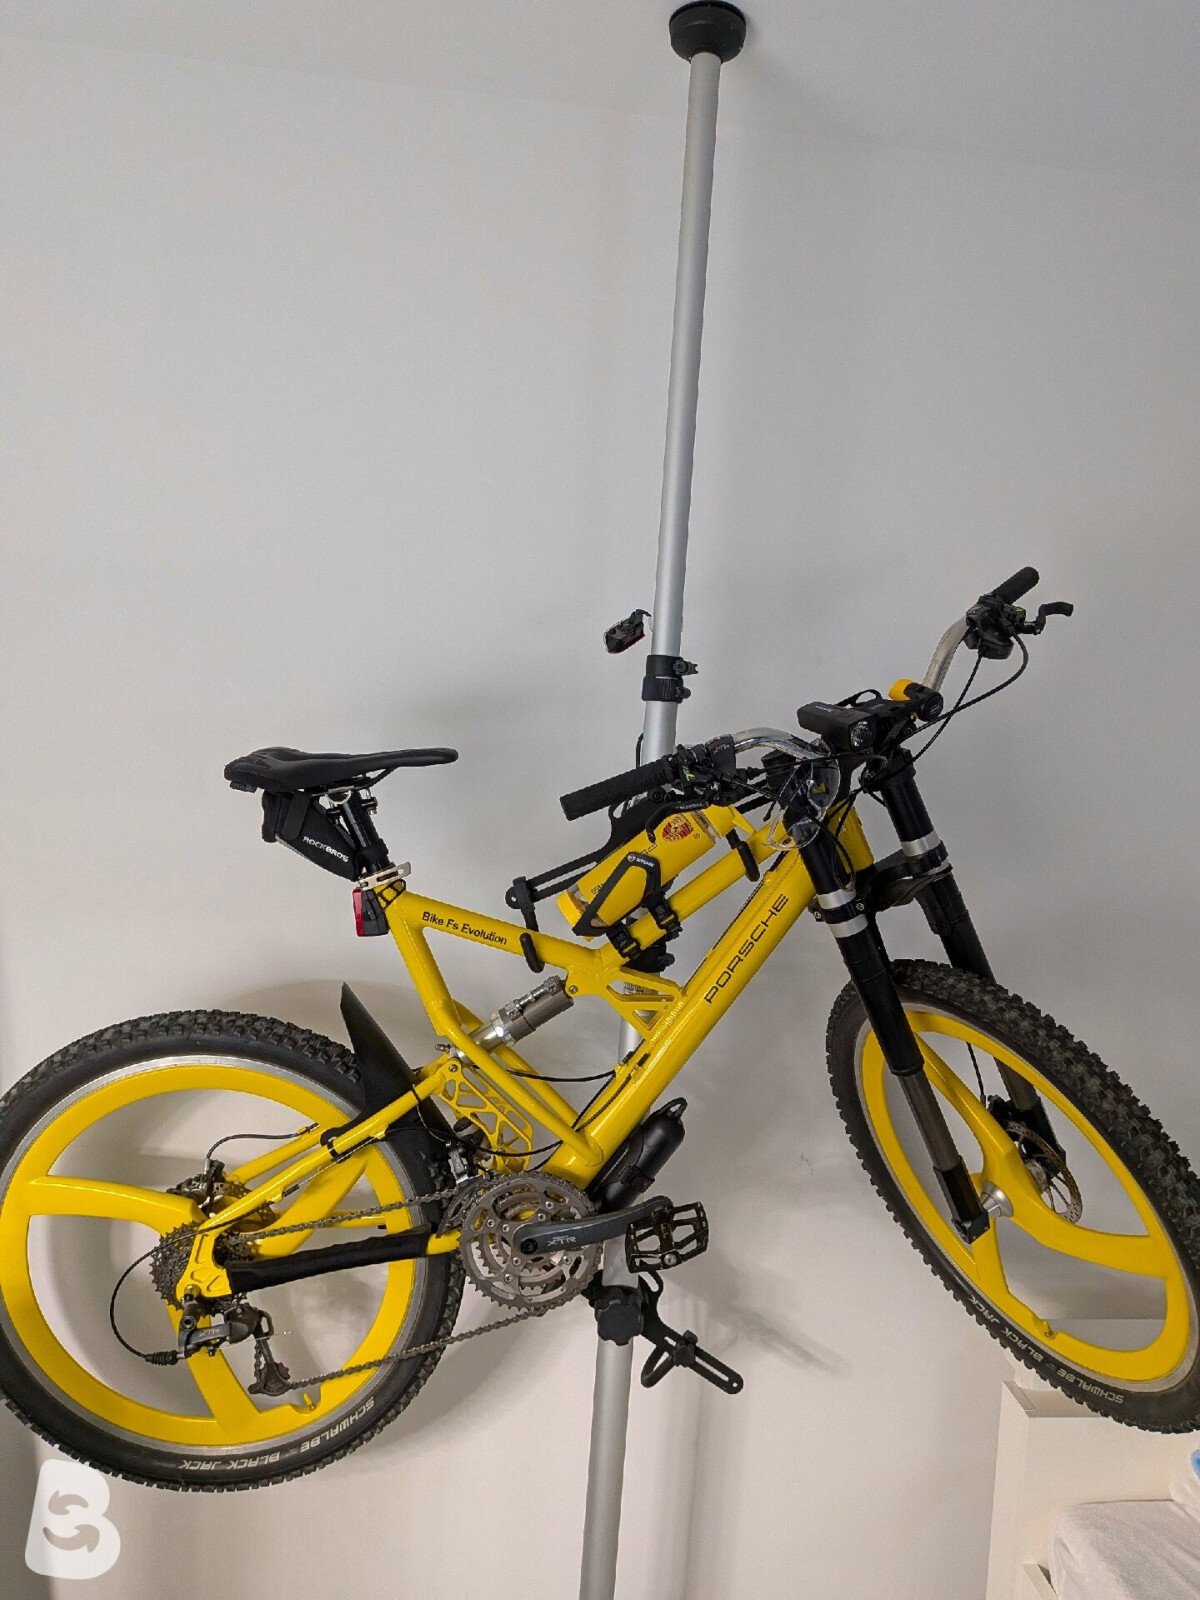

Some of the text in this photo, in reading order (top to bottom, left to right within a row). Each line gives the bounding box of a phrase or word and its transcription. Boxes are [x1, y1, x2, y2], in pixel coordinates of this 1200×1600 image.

[302, 836, 349, 862] ROCKBROS
[422, 911, 508, 946] Bike Fs Evolution
[704, 893, 790, 1004] PORSCHE
[968, 1296, 1125, 1404] SCHWALBE BLACK JACK
[178, 1396, 375, 1471] SCHWALBE BLACK JACK
